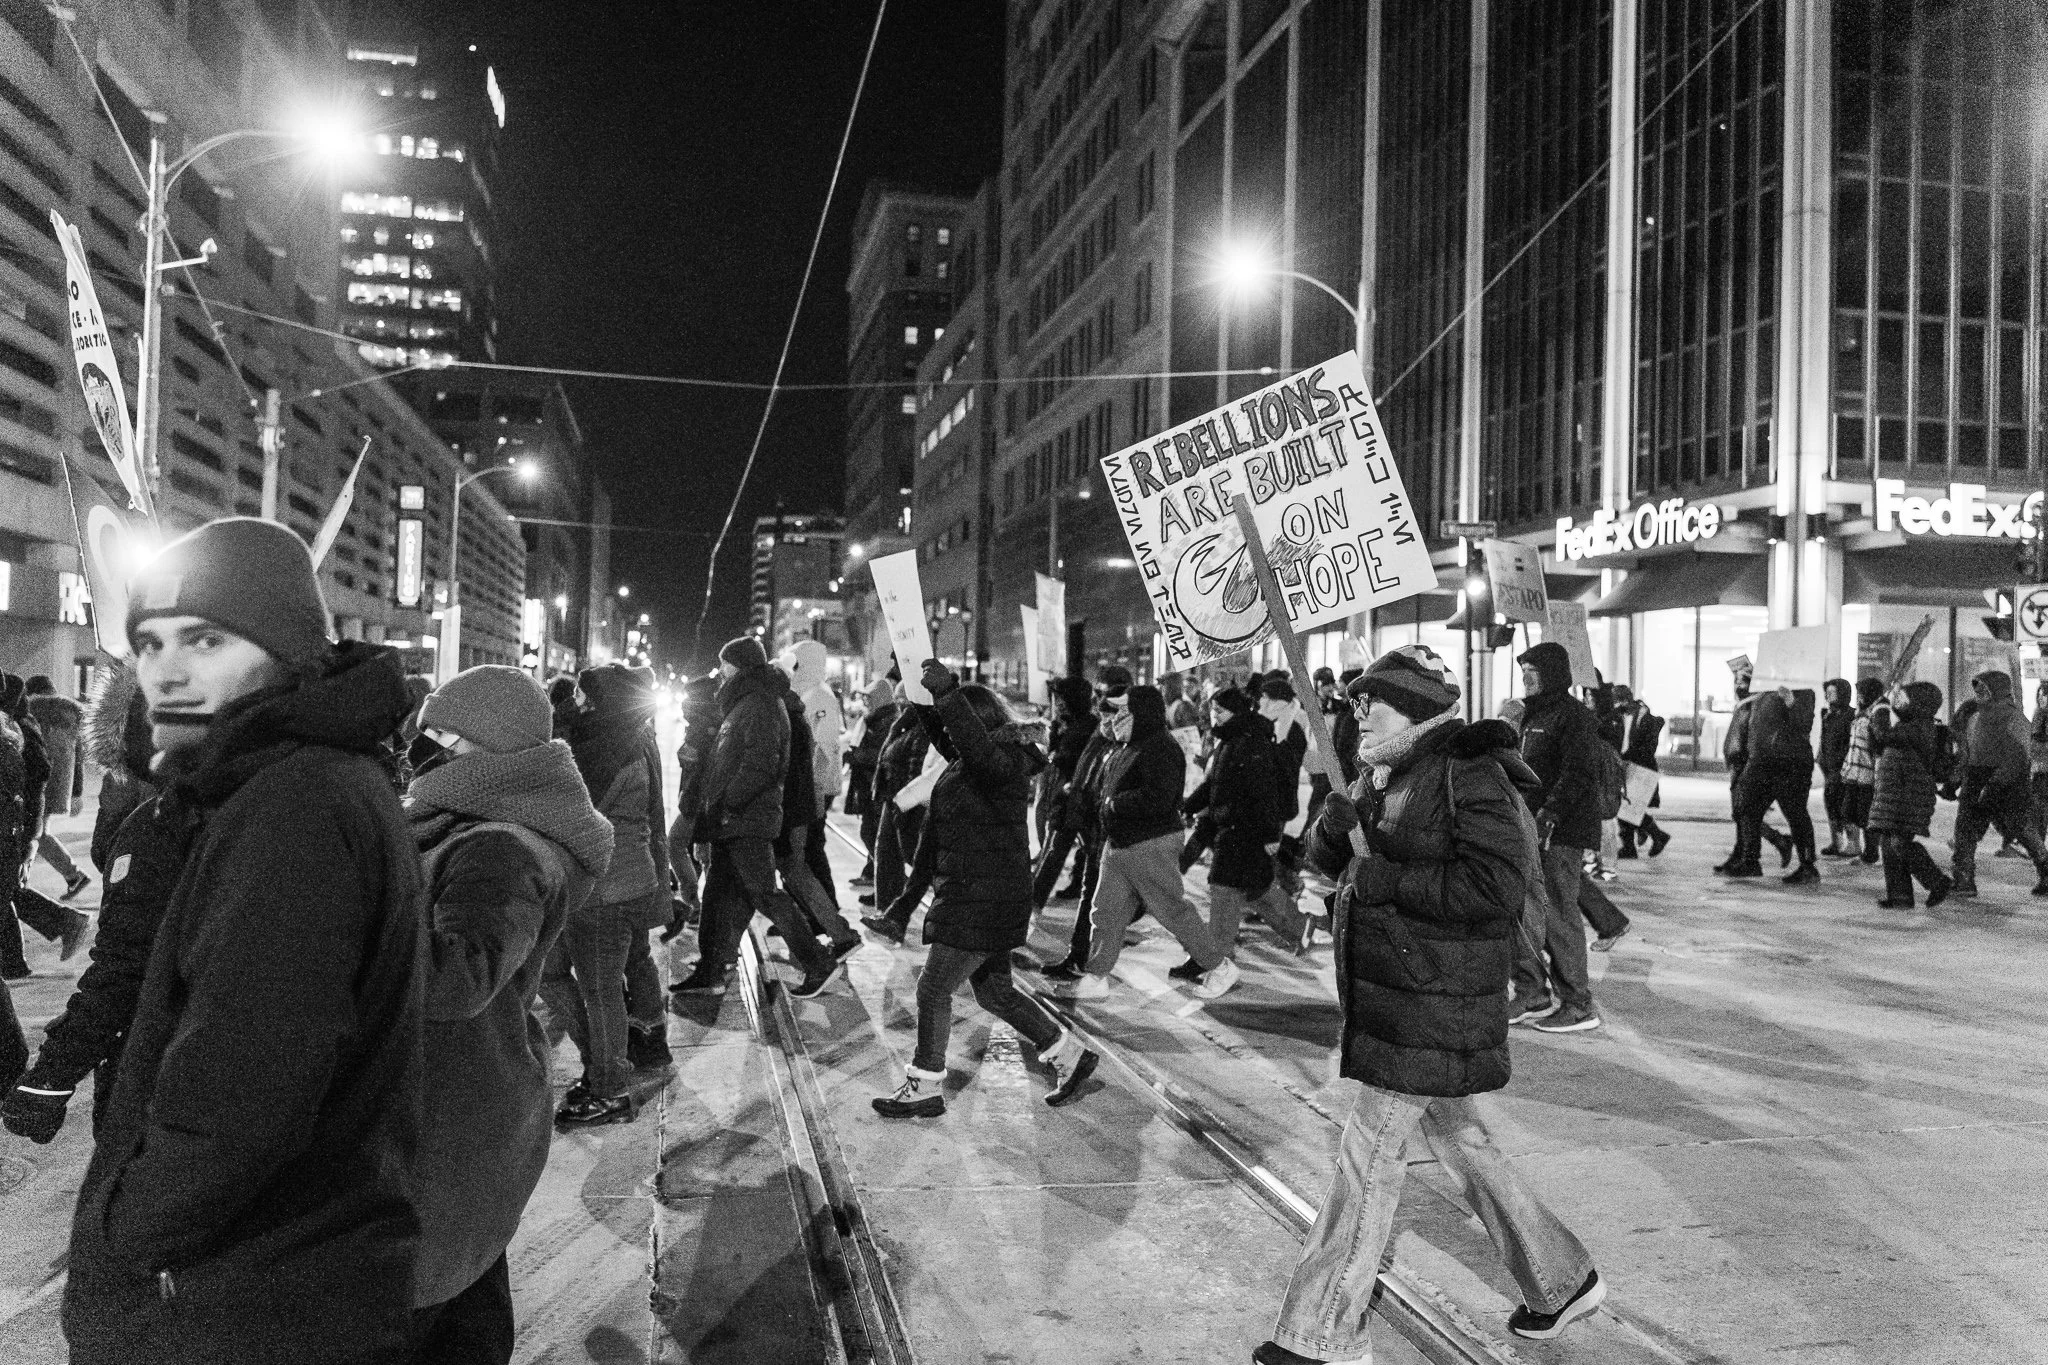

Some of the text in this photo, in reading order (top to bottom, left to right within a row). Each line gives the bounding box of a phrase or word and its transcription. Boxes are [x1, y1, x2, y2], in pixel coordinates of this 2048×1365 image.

[1129, 367, 1341, 498] REBELLIONS
[1161, 471, 1236, 543] ARE
[1245, 421, 1349, 506] BUILT
[1281, 488, 1349, 545] ON
[1876, 478, 2021, 538] FedEx
[1555, 509, 1634, 563] FedEx
[1633, 497, 1720, 550] Office
[1274, 529, 1401, 621] HOPE
